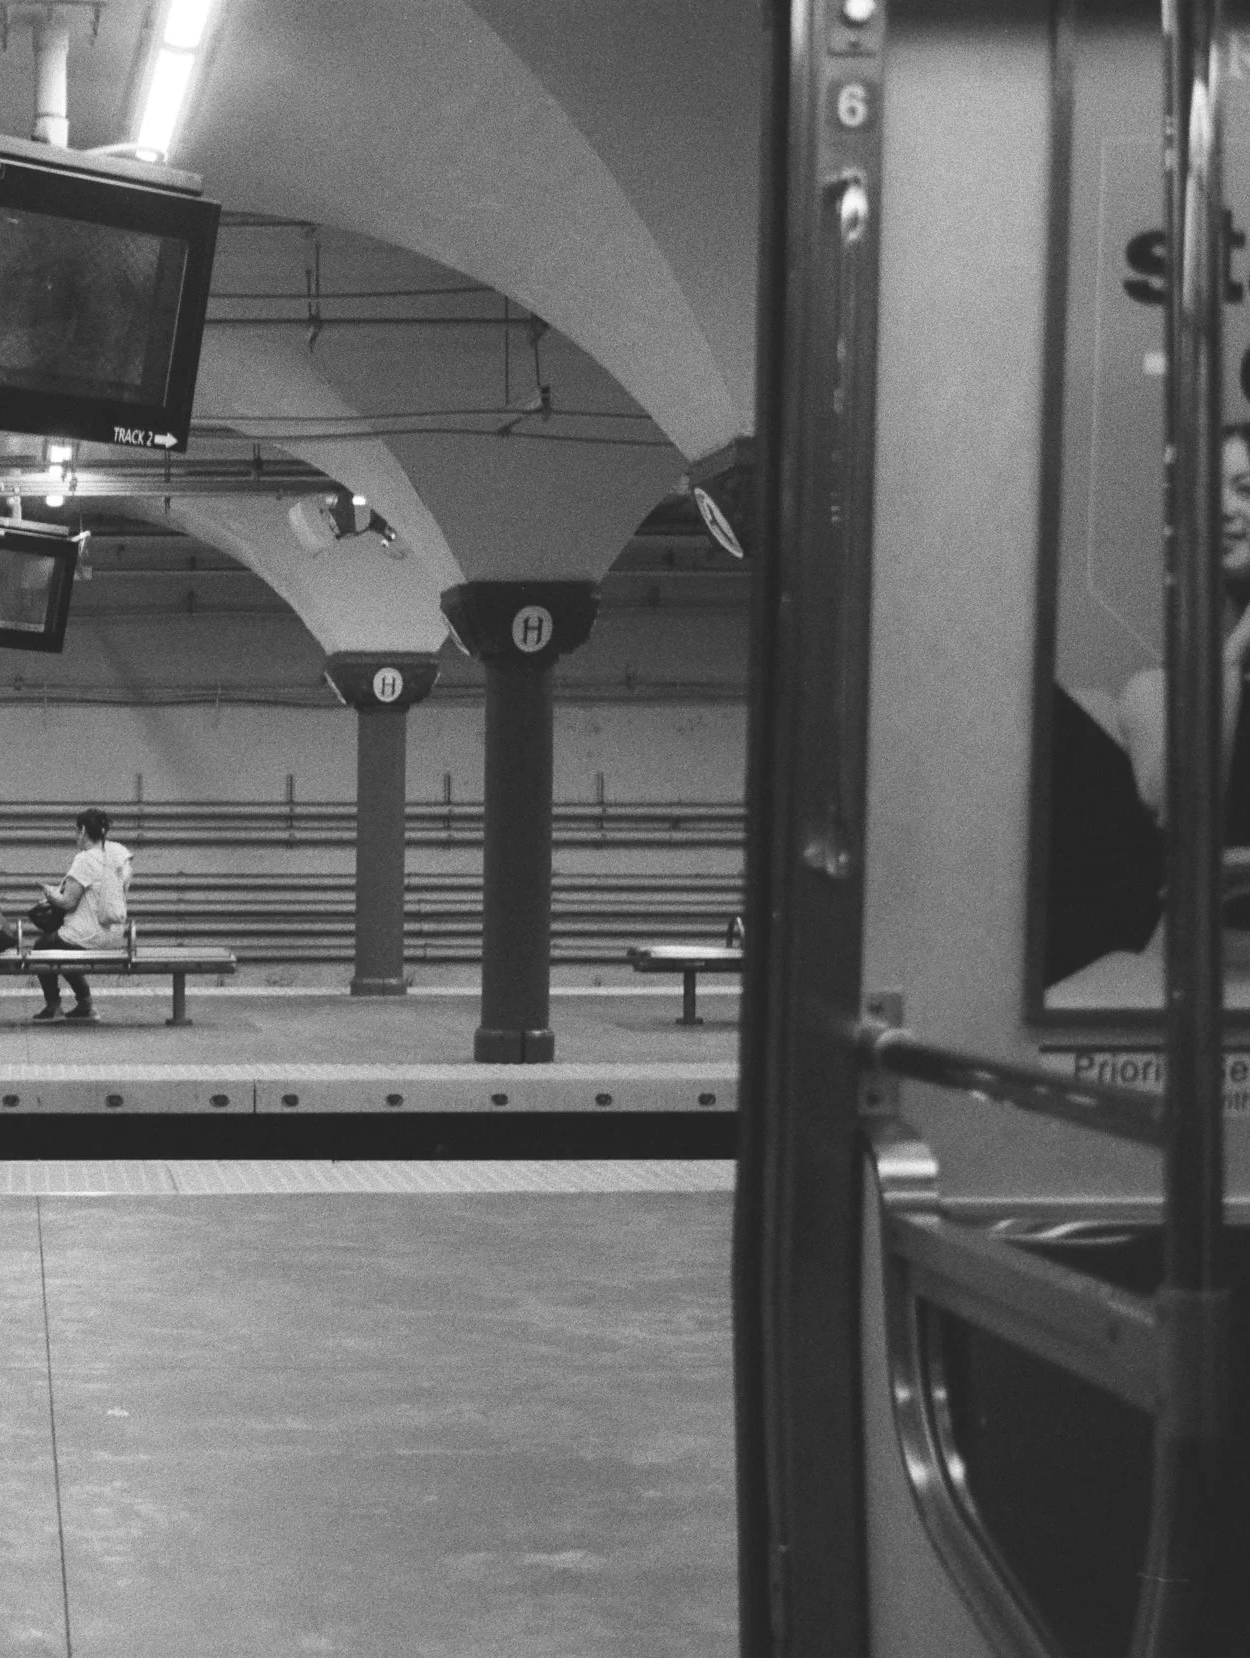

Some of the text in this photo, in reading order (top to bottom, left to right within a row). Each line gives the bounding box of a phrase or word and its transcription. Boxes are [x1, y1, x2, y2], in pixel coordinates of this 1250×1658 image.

[838, 83, 867, 127] 6
[113, 426, 153, 446] TRACK 2
[524, 615, 543, 645] H
[1074, 1054, 1161, 1083] Priori
